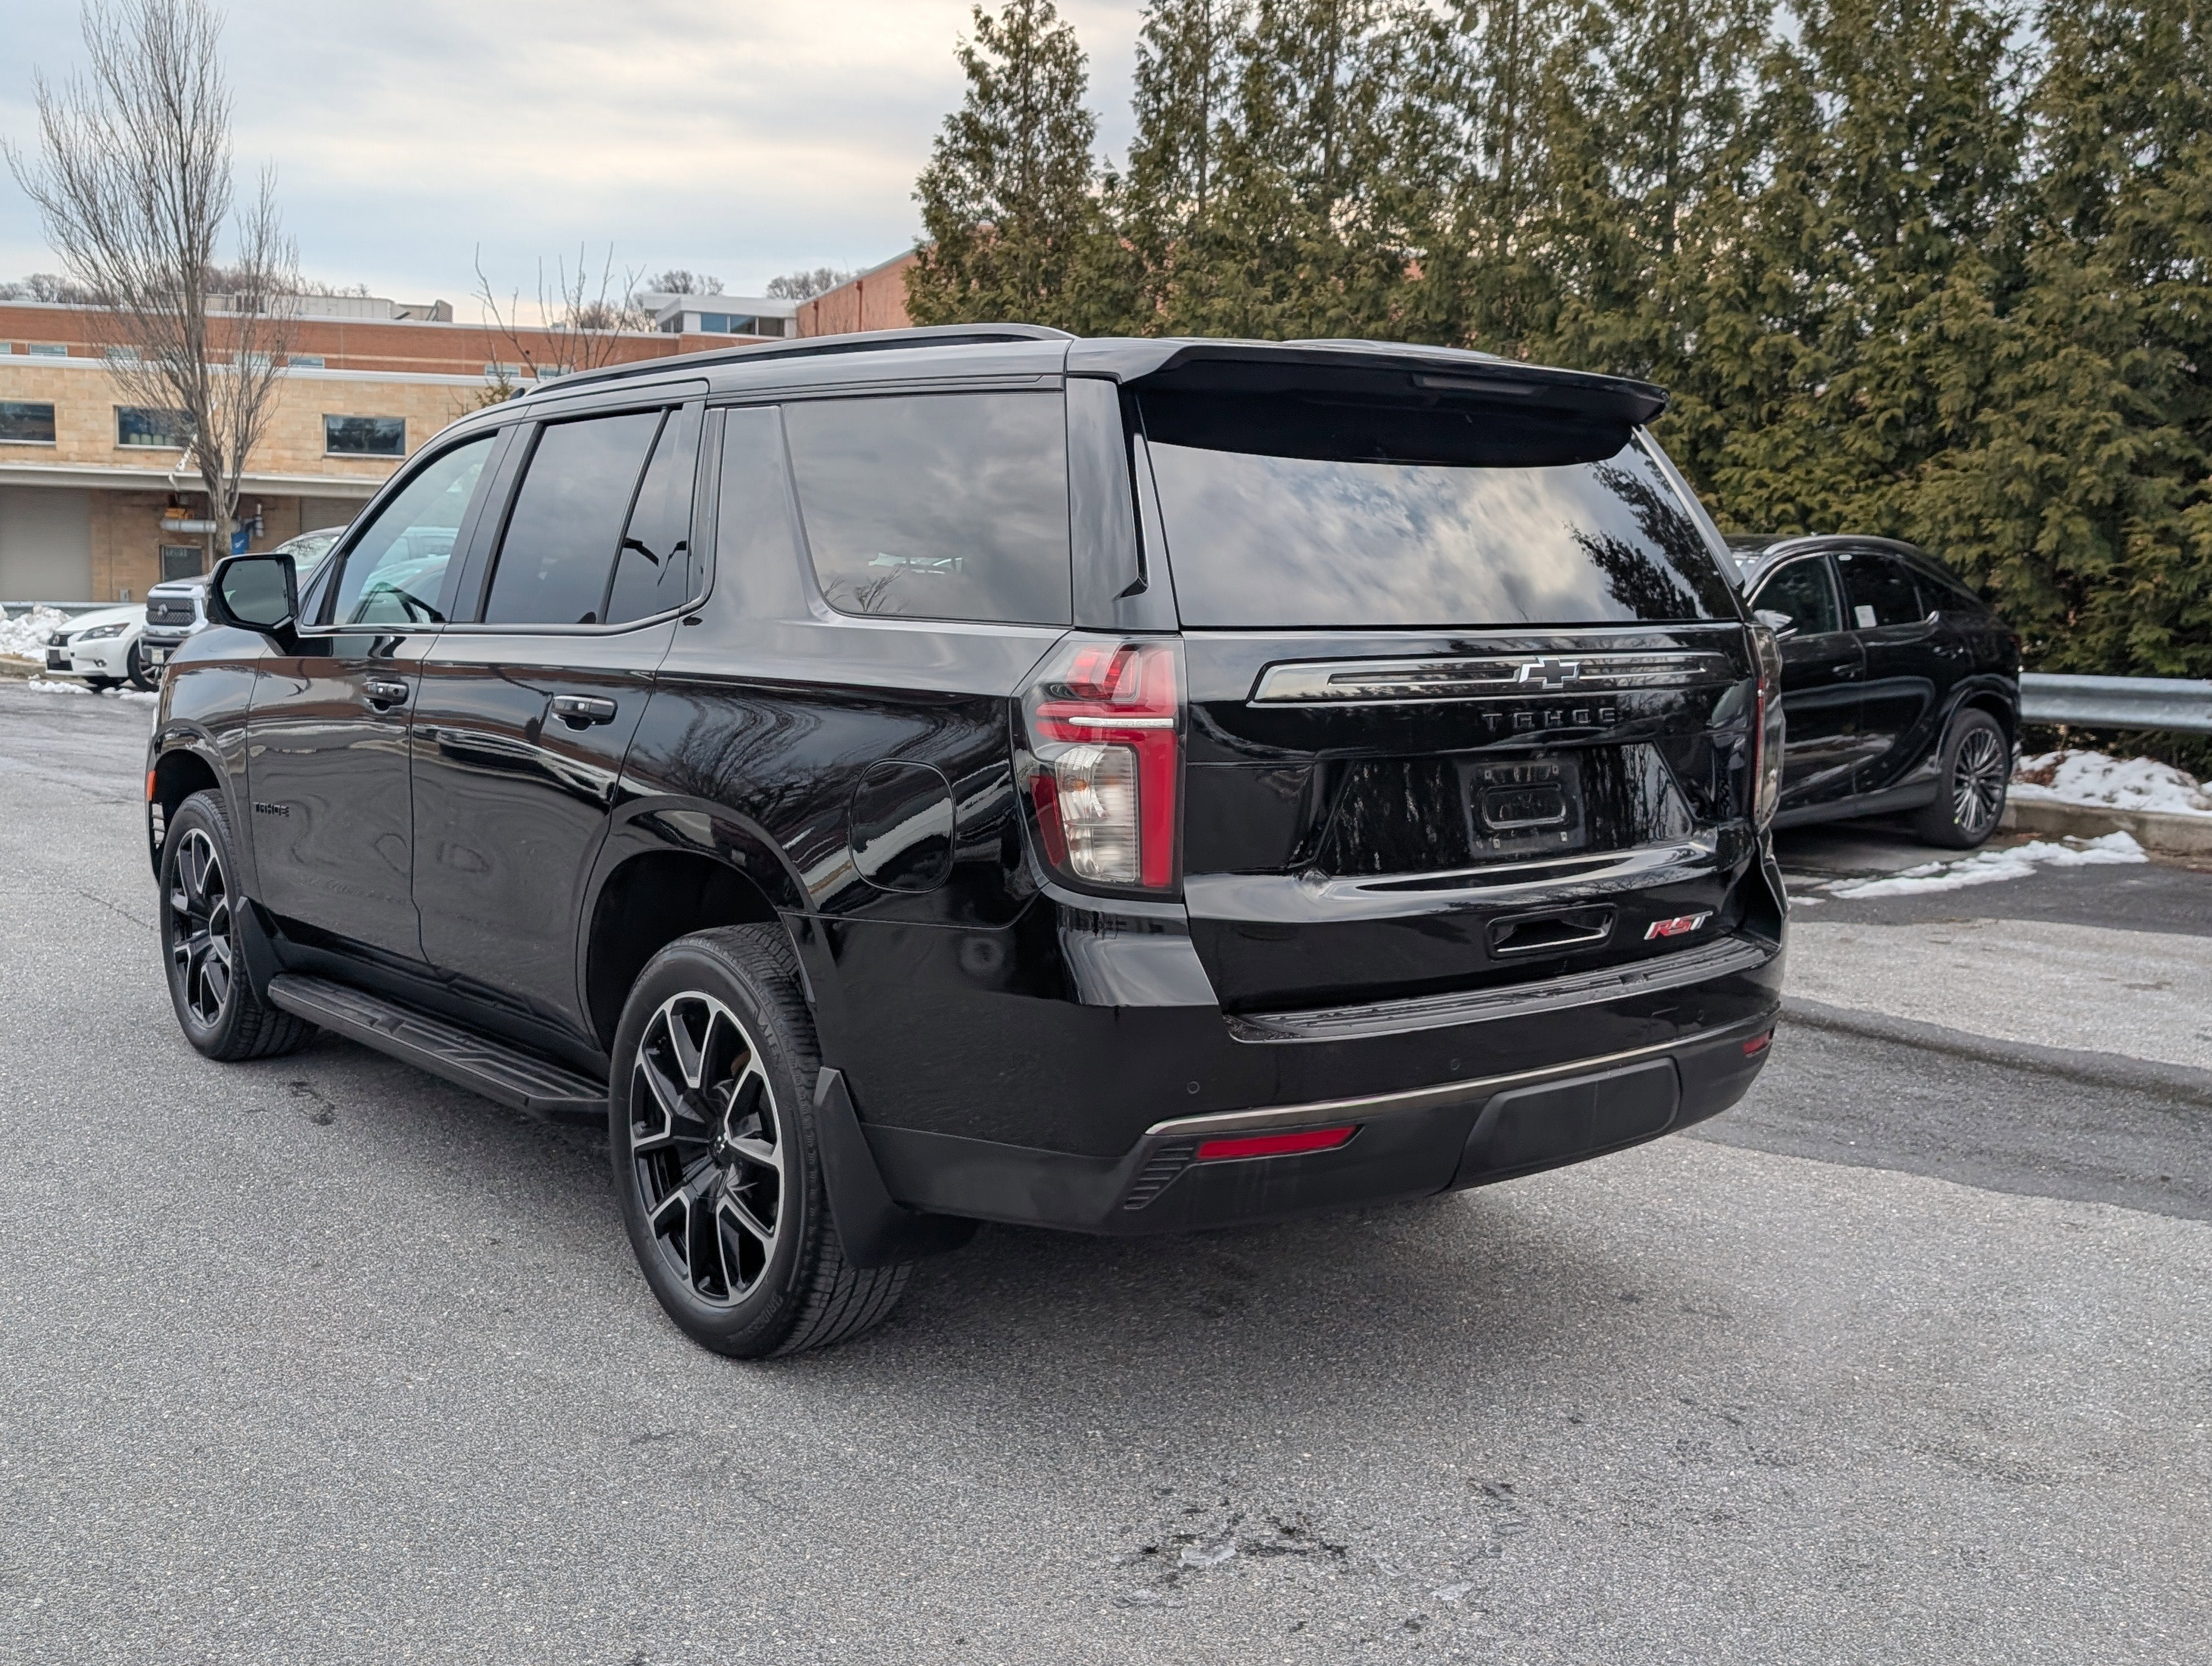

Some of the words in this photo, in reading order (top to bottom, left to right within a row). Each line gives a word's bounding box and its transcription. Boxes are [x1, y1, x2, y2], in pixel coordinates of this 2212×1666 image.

[1482, 707, 1617, 731] TAHOE
[252, 802, 290, 817] TAHOE
[1643, 911, 1714, 940] RST
